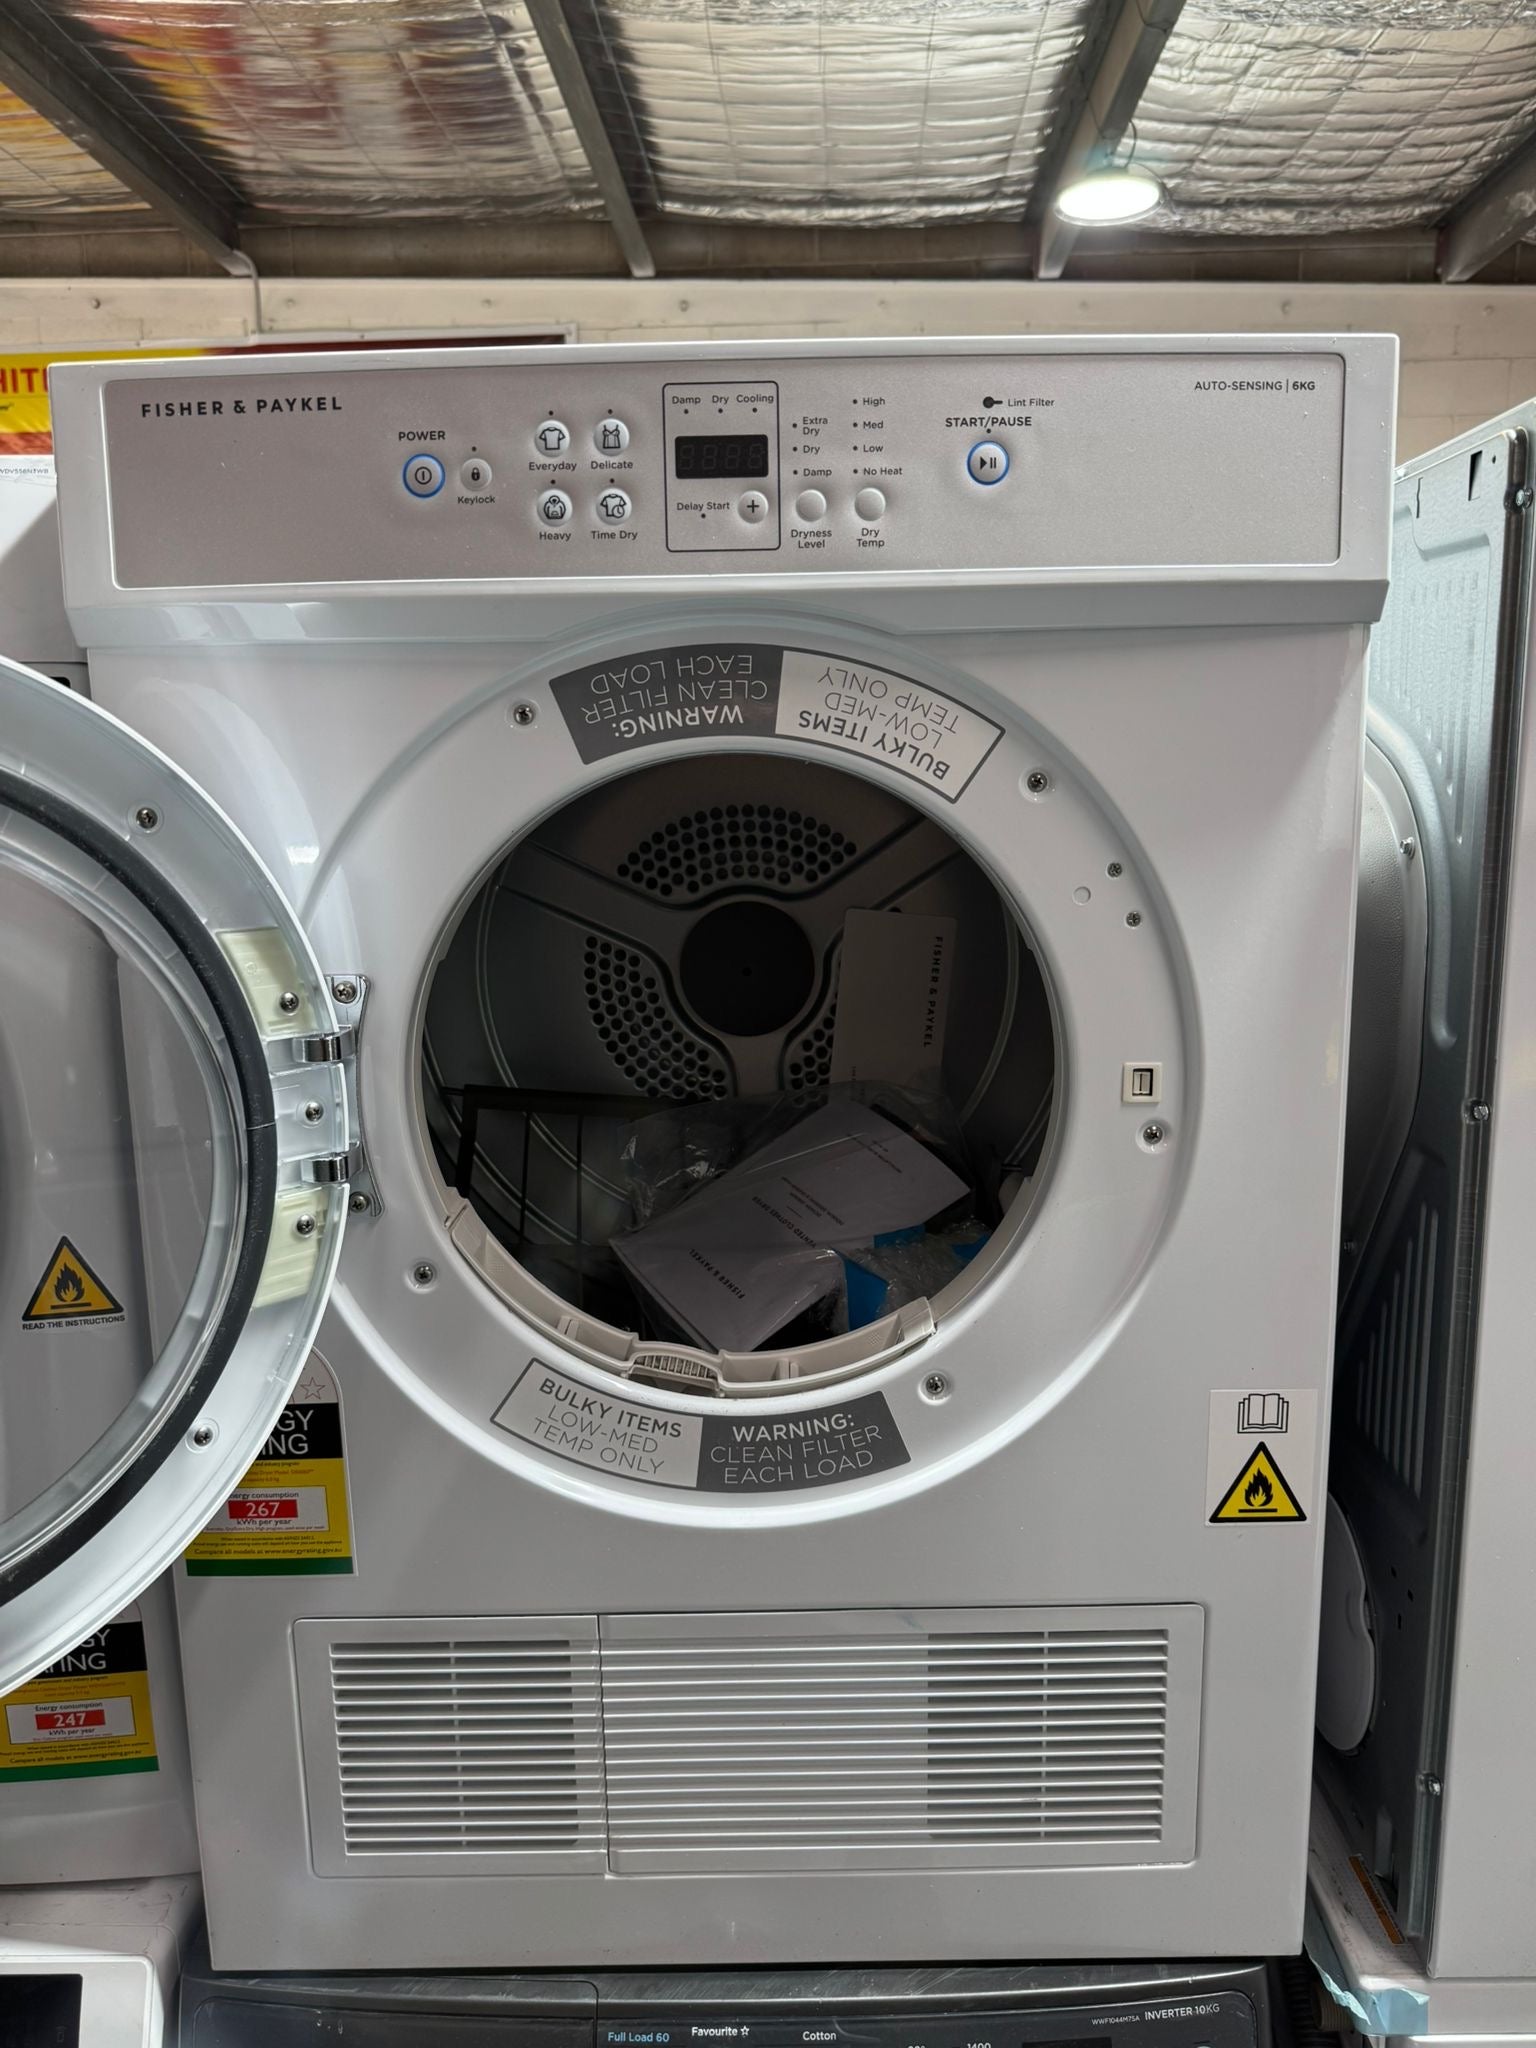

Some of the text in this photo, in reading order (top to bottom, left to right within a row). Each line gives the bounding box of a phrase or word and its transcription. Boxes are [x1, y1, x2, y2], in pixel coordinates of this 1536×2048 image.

[1194, 380, 1316, 391] AUTO-SENSING 6KG
[671, 394, 774, 406] Damp Dry Cooling
[862, 397, 886, 407] High
[1007, 398, 1055, 407] Lint Filter
[142, 397, 342, 417] FISHER & PAYKEL
[802, 416, 828, 425] Extra
[862, 420, 884, 430] Med
[945, 415, 1033, 428] START/PAUSE
[398, 430, 446, 441] POWER
[802, 426, 820, 437] Dry
[803, 444, 820, 455] Dry
[862, 443, 884, 453] Low
[528, 461, 577, 472] Everyday
[590, 460, 633, 470] Delicate
[863, 466, 903, 476] No Heat
[803, 468, 832, 478] Damp
[457, 495, 496, 506] Keylock
[676, 501, 730, 513] Delay Start
[539, 531, 571, 542] Heavy
[590, 530, 638, 541] Time Dry
[790, 529, 832, 539] Dryness
[861, 528, 880, 538] Dry
[798, 539, 826, 549] Level
[856, 538, 885, 549] Temp
[589, 654, 754, 695] EACH LOAD
[580, 679, 769, 725] CLEAN FILTER
[817, 665, 960, 736] TEMP ONLY
[613, 704, 744, 739] WARNING:
[824, 691, 944, 750] LOW-MED
[798, 708, 952, 781] BULKY ITEMS
[930, 936, 944, 983] FISHER
[923, 1000, 936, 1048] PAYKEL
[22, 1314, 126, 1330] READ THE INSTRUCTIONS
[538, 1377, 683, 1438] BULKY ITEMS
[276, 1409, 314, 1431] GY
[546, 1403, 660, 1455] LOW-MED
[732, 1412, 856, 1443] WARNING:
[532, 1416, 666, 1475] TEMP ONLY
[710, 1425, 884, 1465] CLEAN FILTER
[723, 1450, 875, 1486] EACH LOAD
[230, 1491, 299, 1500] nergy consumption
[246, 1502, 280, 1518] 267
[237, 1518, 292, 1527] kWh per year
[35, 1704, 58, 1712] Energy
[54, 1712, 87, 1728] 247
[1144, 2006, 1193, 2020] INVERTER
[1194, 2003, 1220, 2015] 10KG
[607, 2031, 670, 2043] Full Load 60
[691, 2026, 738, 2038] Favourite
[802, 2030, 837, 2041] Cotton
